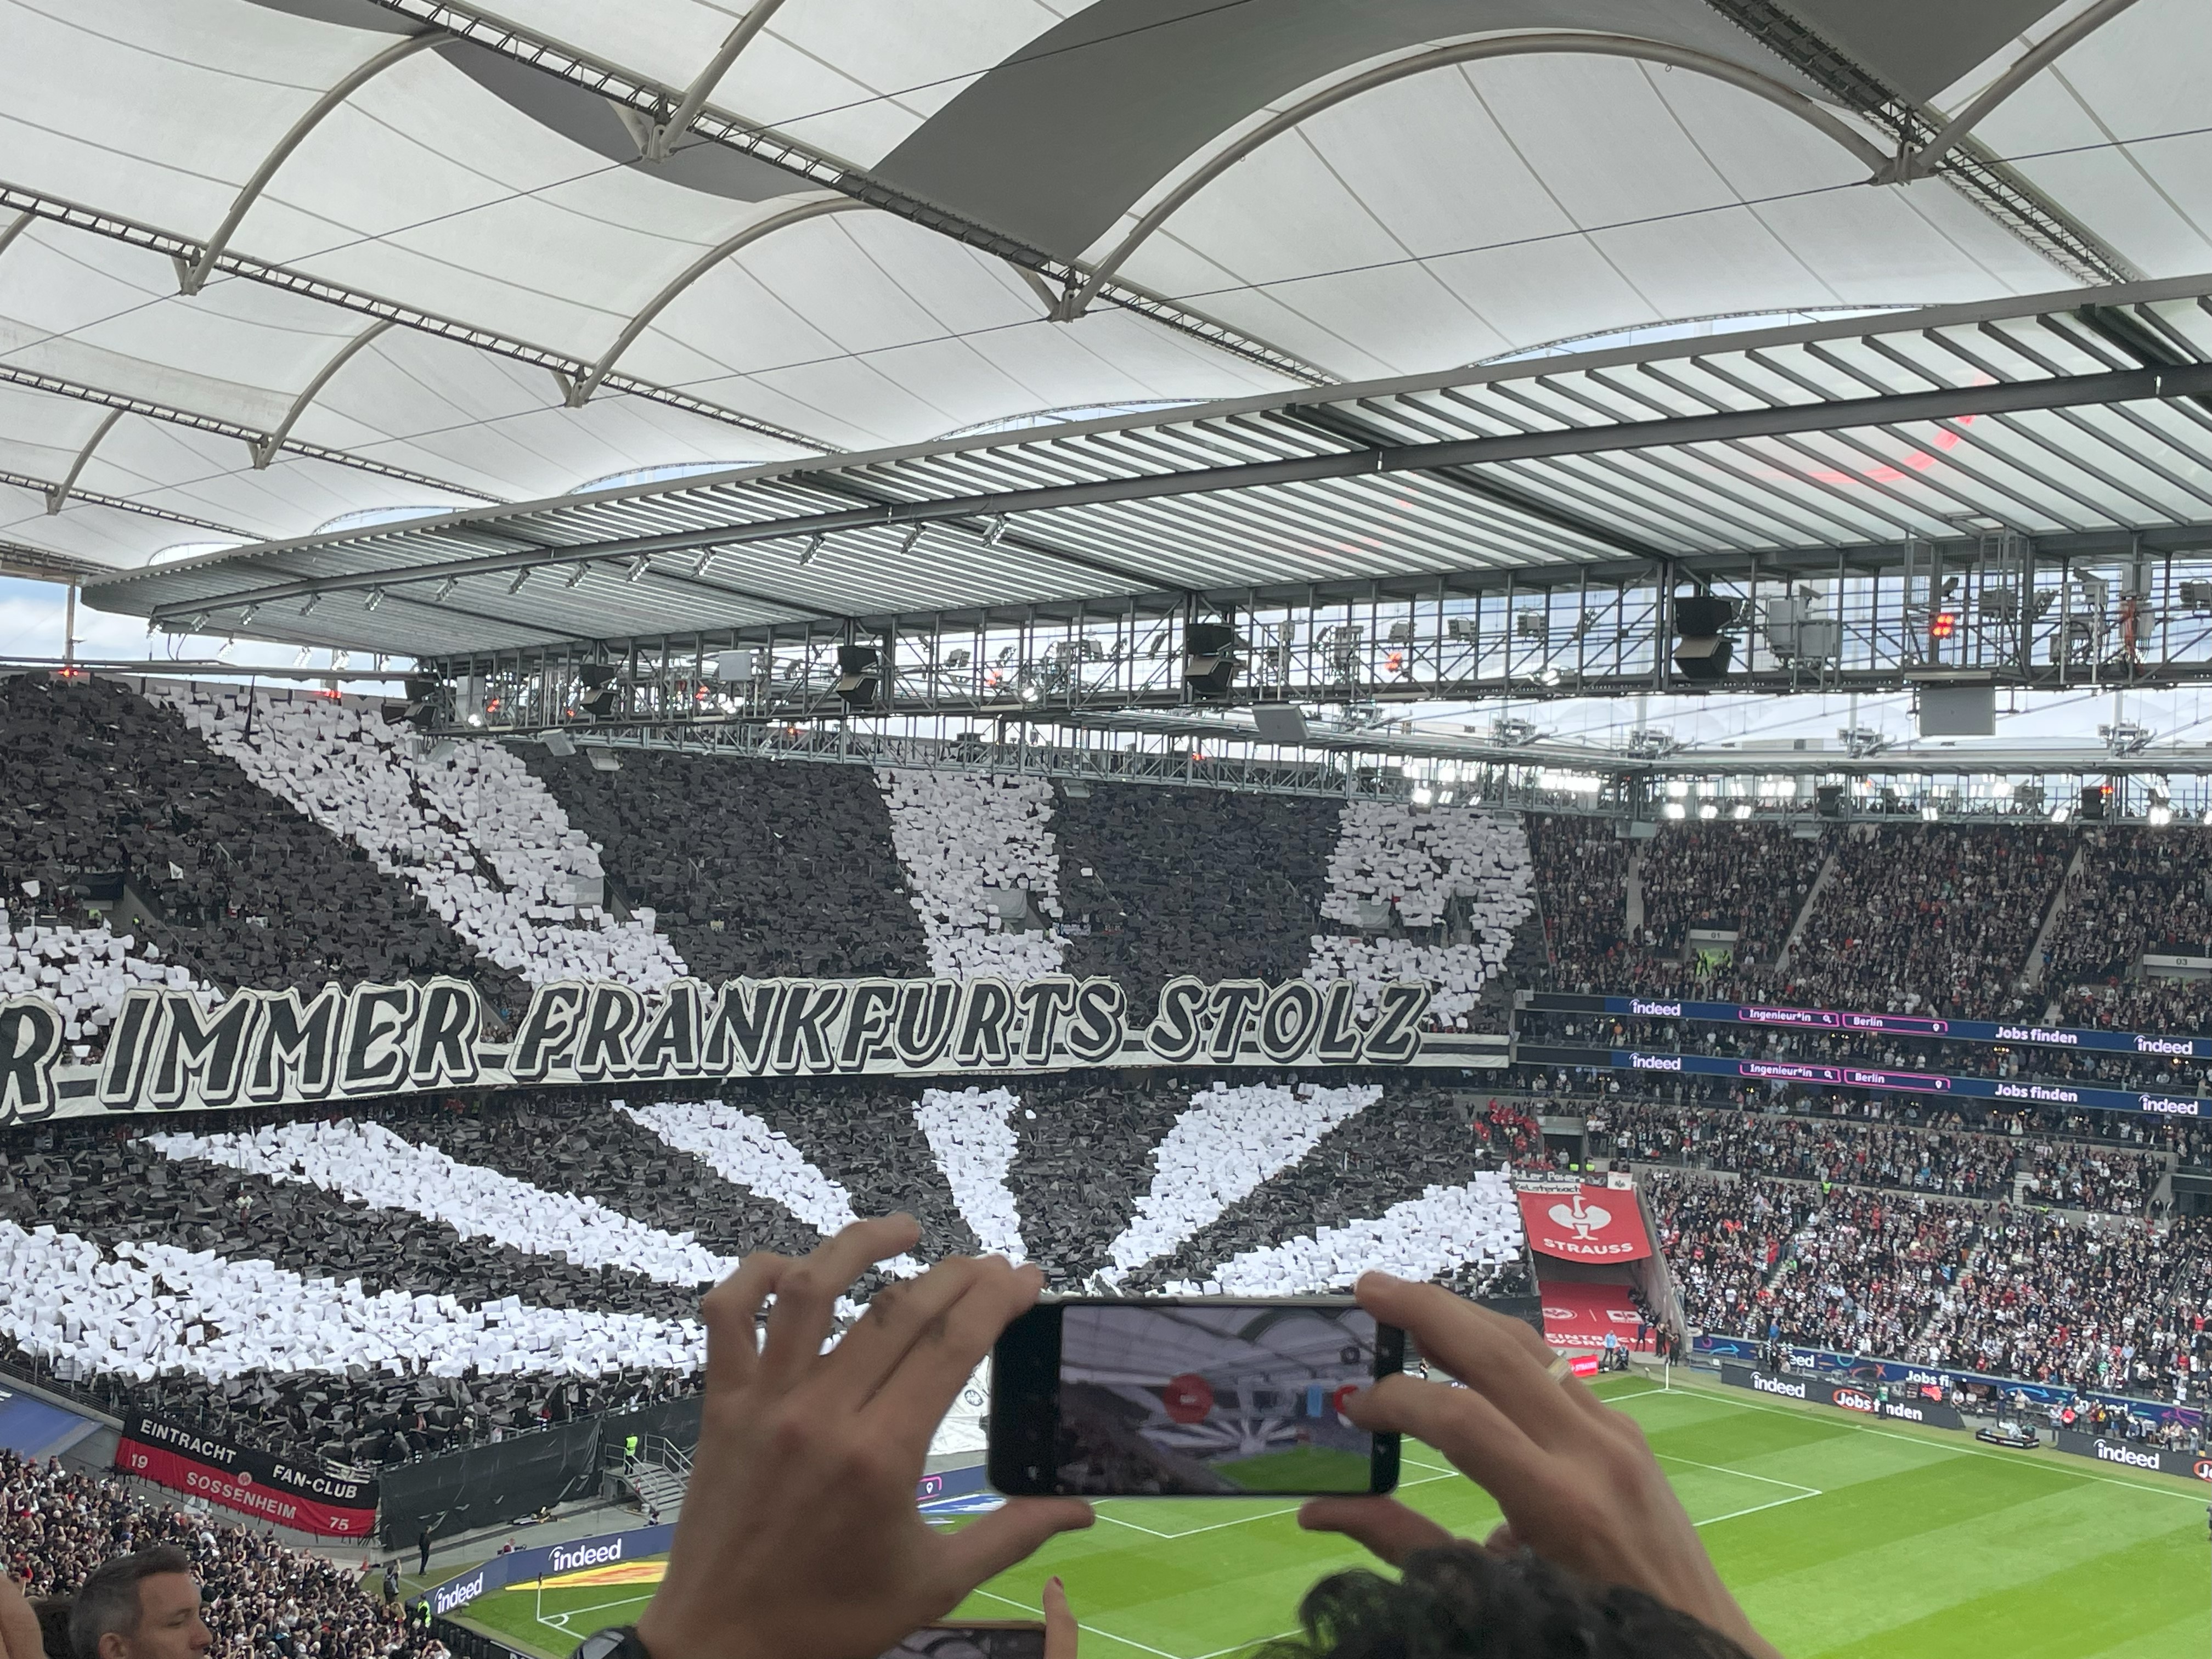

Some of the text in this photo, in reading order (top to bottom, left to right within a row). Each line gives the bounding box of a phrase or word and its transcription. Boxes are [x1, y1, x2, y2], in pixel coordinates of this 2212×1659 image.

[1629, 998, 1681, 1016] indeed
[1853, 1016, 1883, 1027] Berlin
[100, 976, 482, 1110] IMMER
[508, 977, 1126, 1081] FRANKFURTS
[1144, 976, 1430, 1064] STOLZ
[1995, 1026, 2078, 1044] Jobs finden
[2133, 1035, 2193, 1056] indeed
[1629, 1052, 1681, 1070] indeed
[1855, 1072, 1885, 1084] Berlin
[1995, 1084, 2078, 1103] Jobs finden
[2138, 1092, 2199, 1115] indeed
[1543, 1238, 1634, 1255] STRAUSS
[1750, 1371, 1805, 1399] indeed
[1905, 1370, 1937, 1385] Jobs
[1838, 1392, 1922, 1421] Jobs fnden
[131, 1453, 148, 1469] 19
[140, 1418, 358, 1500] EINTRACHT FAN-CLUB
[2092, 1438, 2160, 1470] indeed
[187, 1471, 297, 1520] SOSSENHEIM
[329, 1516, 349, 1531] 75
[549, 1538, 622, 1572] indeed
[434, 1571, 483, 1615] indeed
